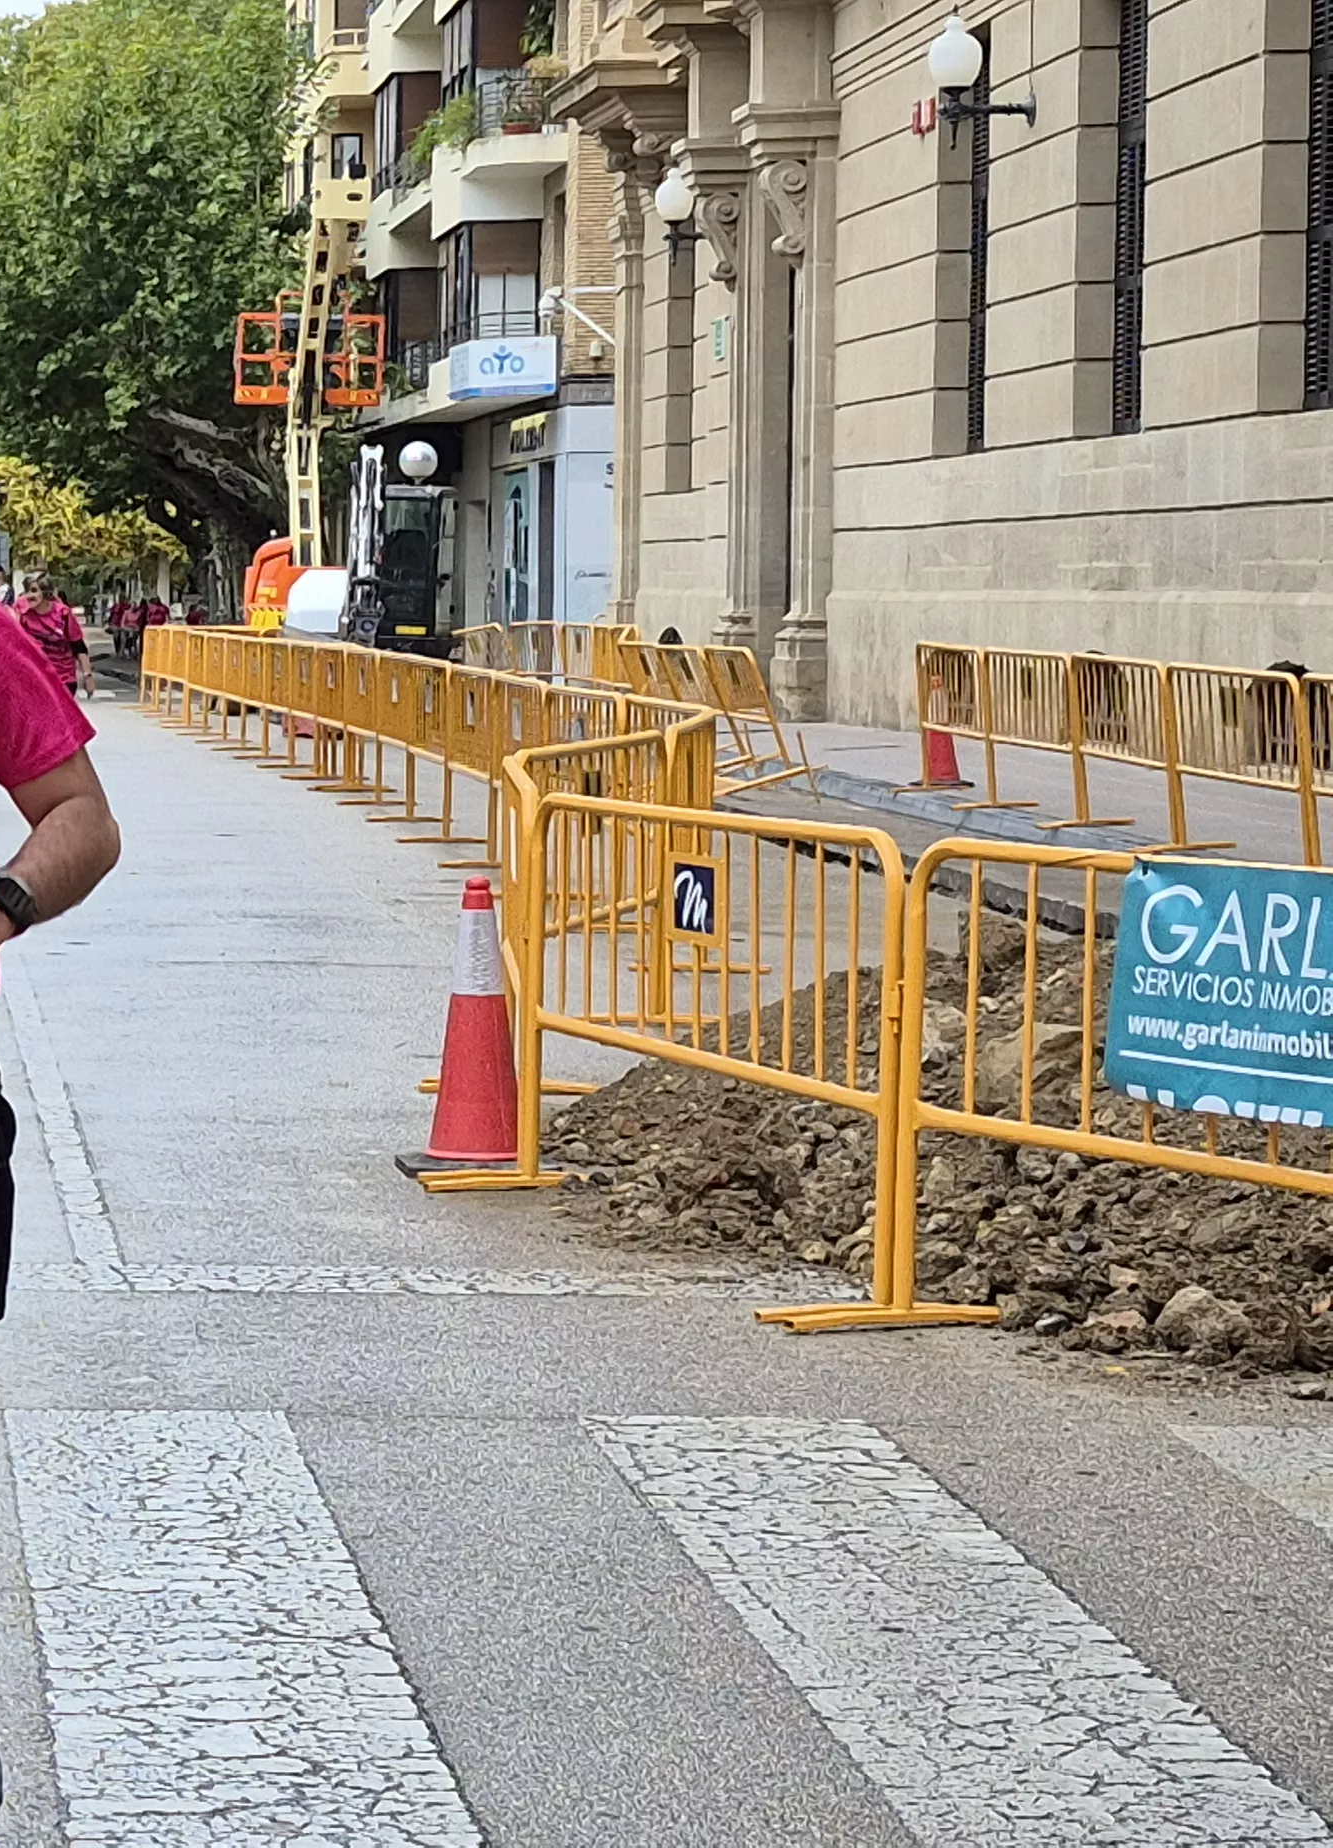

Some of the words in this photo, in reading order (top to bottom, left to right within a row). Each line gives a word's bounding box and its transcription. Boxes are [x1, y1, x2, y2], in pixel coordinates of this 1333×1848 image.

[1141, 884, 1333, 980] GARL
[1132, 965, 1257, 1008] SERVICIOS
[1127, 1013, 1333, 1061] www.garlaninmobil
